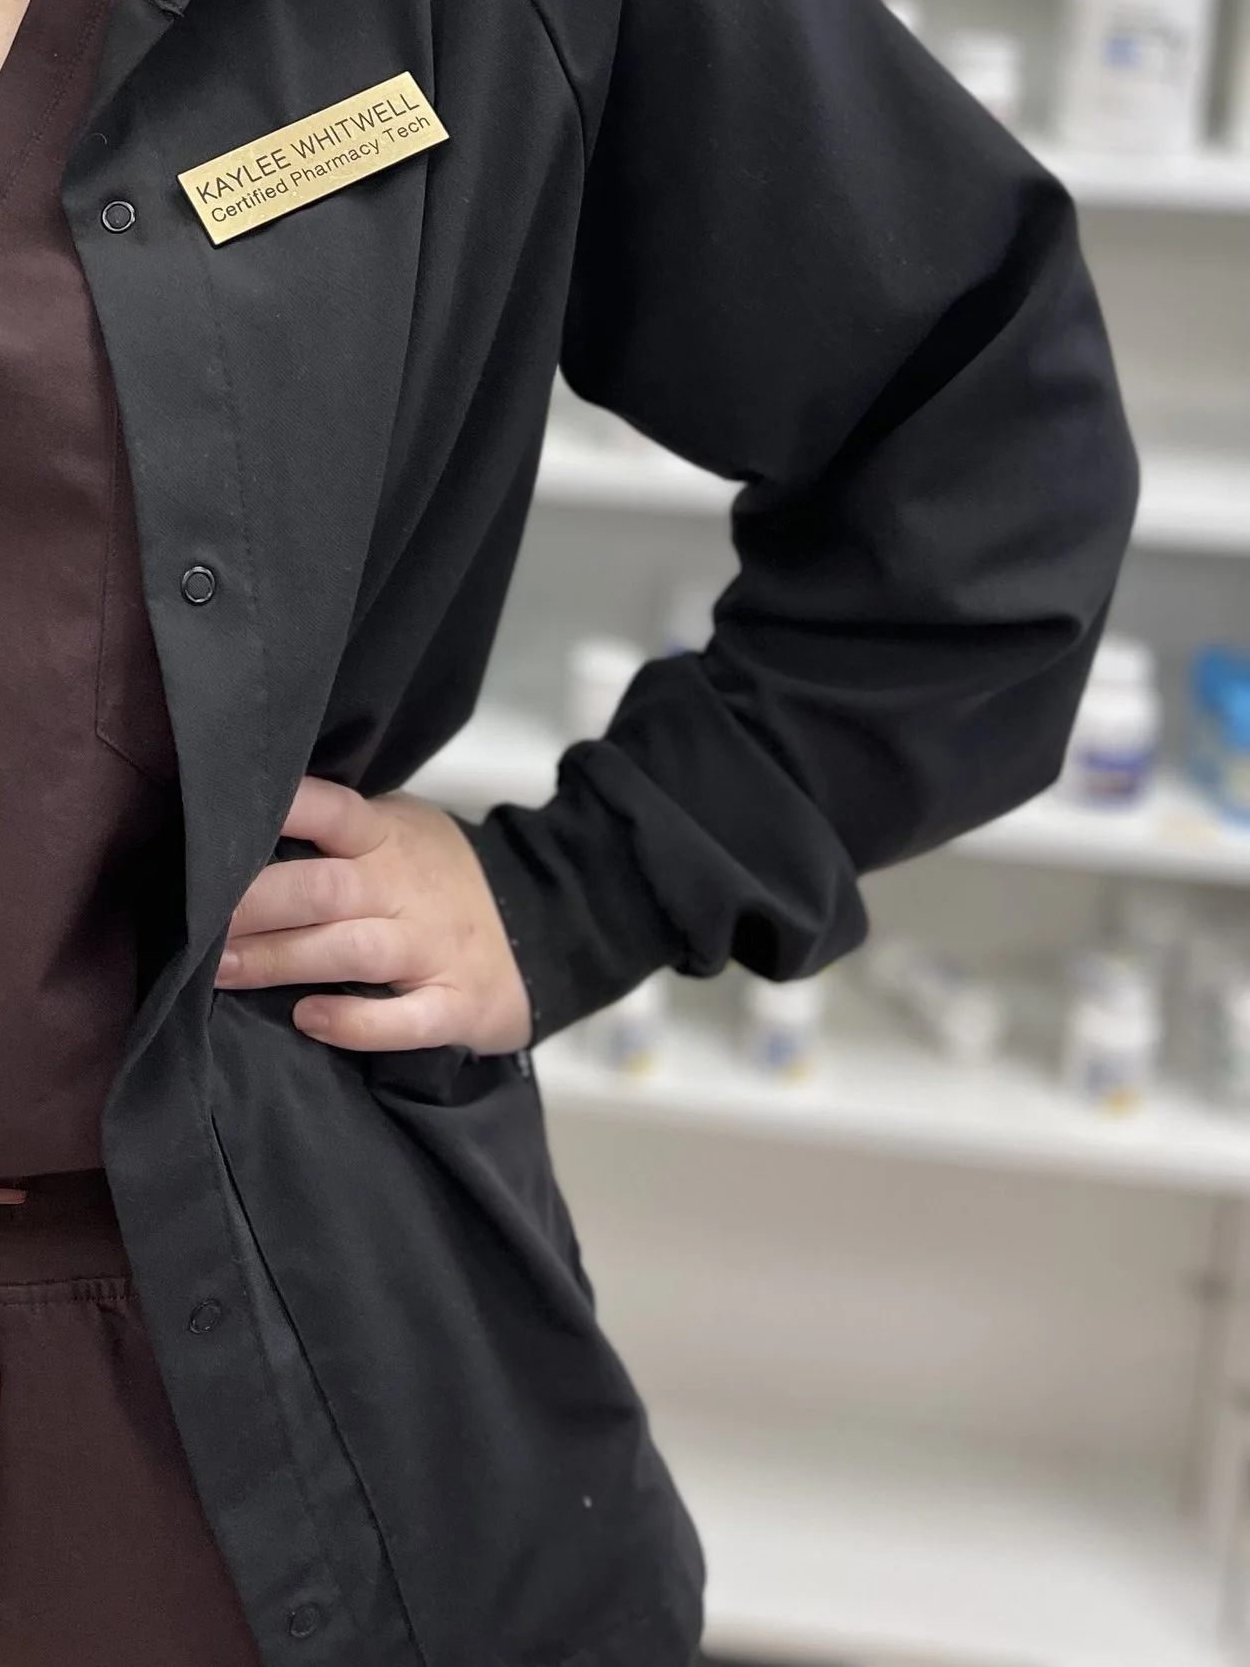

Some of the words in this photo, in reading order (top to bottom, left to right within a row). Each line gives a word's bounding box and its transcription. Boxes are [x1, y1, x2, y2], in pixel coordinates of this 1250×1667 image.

[196, 148, 291, 204] KAYLEE
[291, 93, 420, 160] WHITWELL
[211, 178, 290, 223] Certified
[291, 139, 380, 188] Pharmacy
[382, 116, 431, 143] Tech
